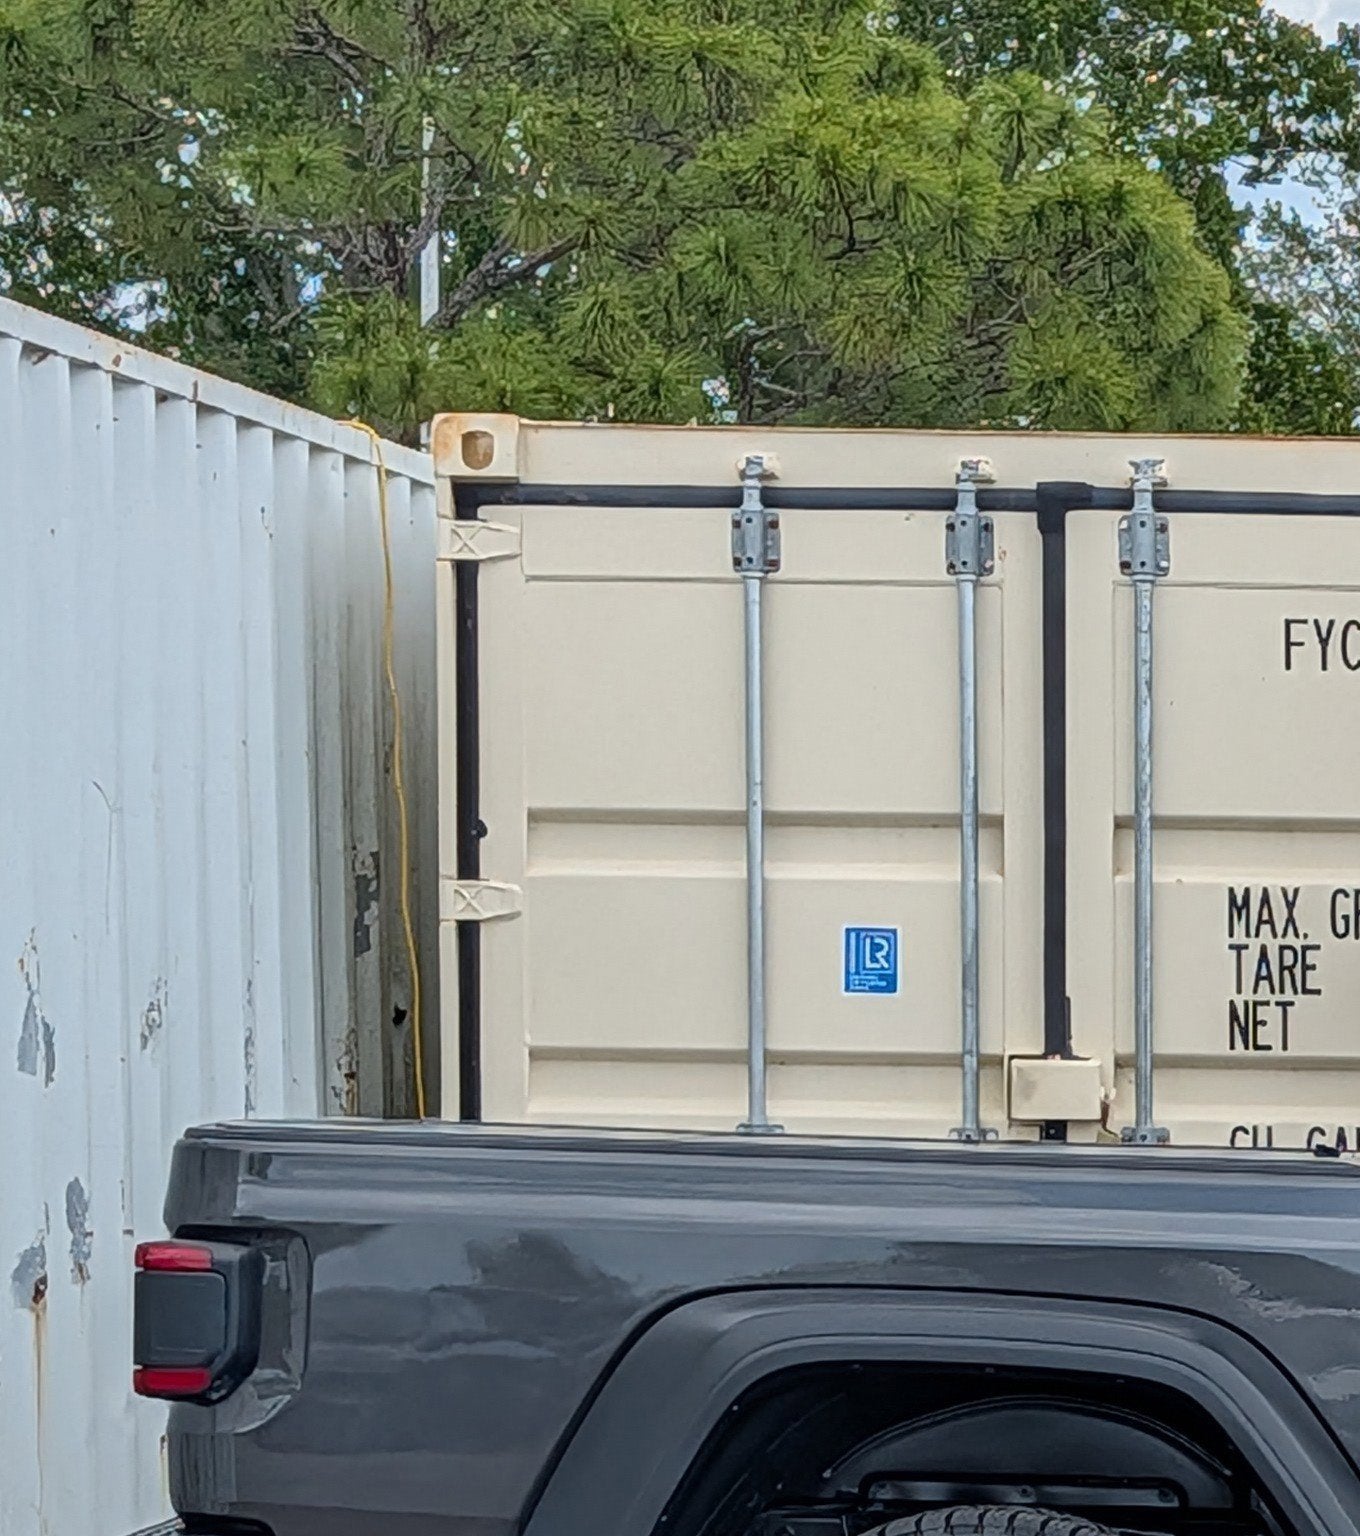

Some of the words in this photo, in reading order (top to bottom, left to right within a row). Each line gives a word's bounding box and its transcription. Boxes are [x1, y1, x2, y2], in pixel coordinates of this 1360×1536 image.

[1228, 886, 1309, 940] MAX.
[1228, 943, 1322, 996] TARE
[1229, 1000, 1296, 1051] NET
